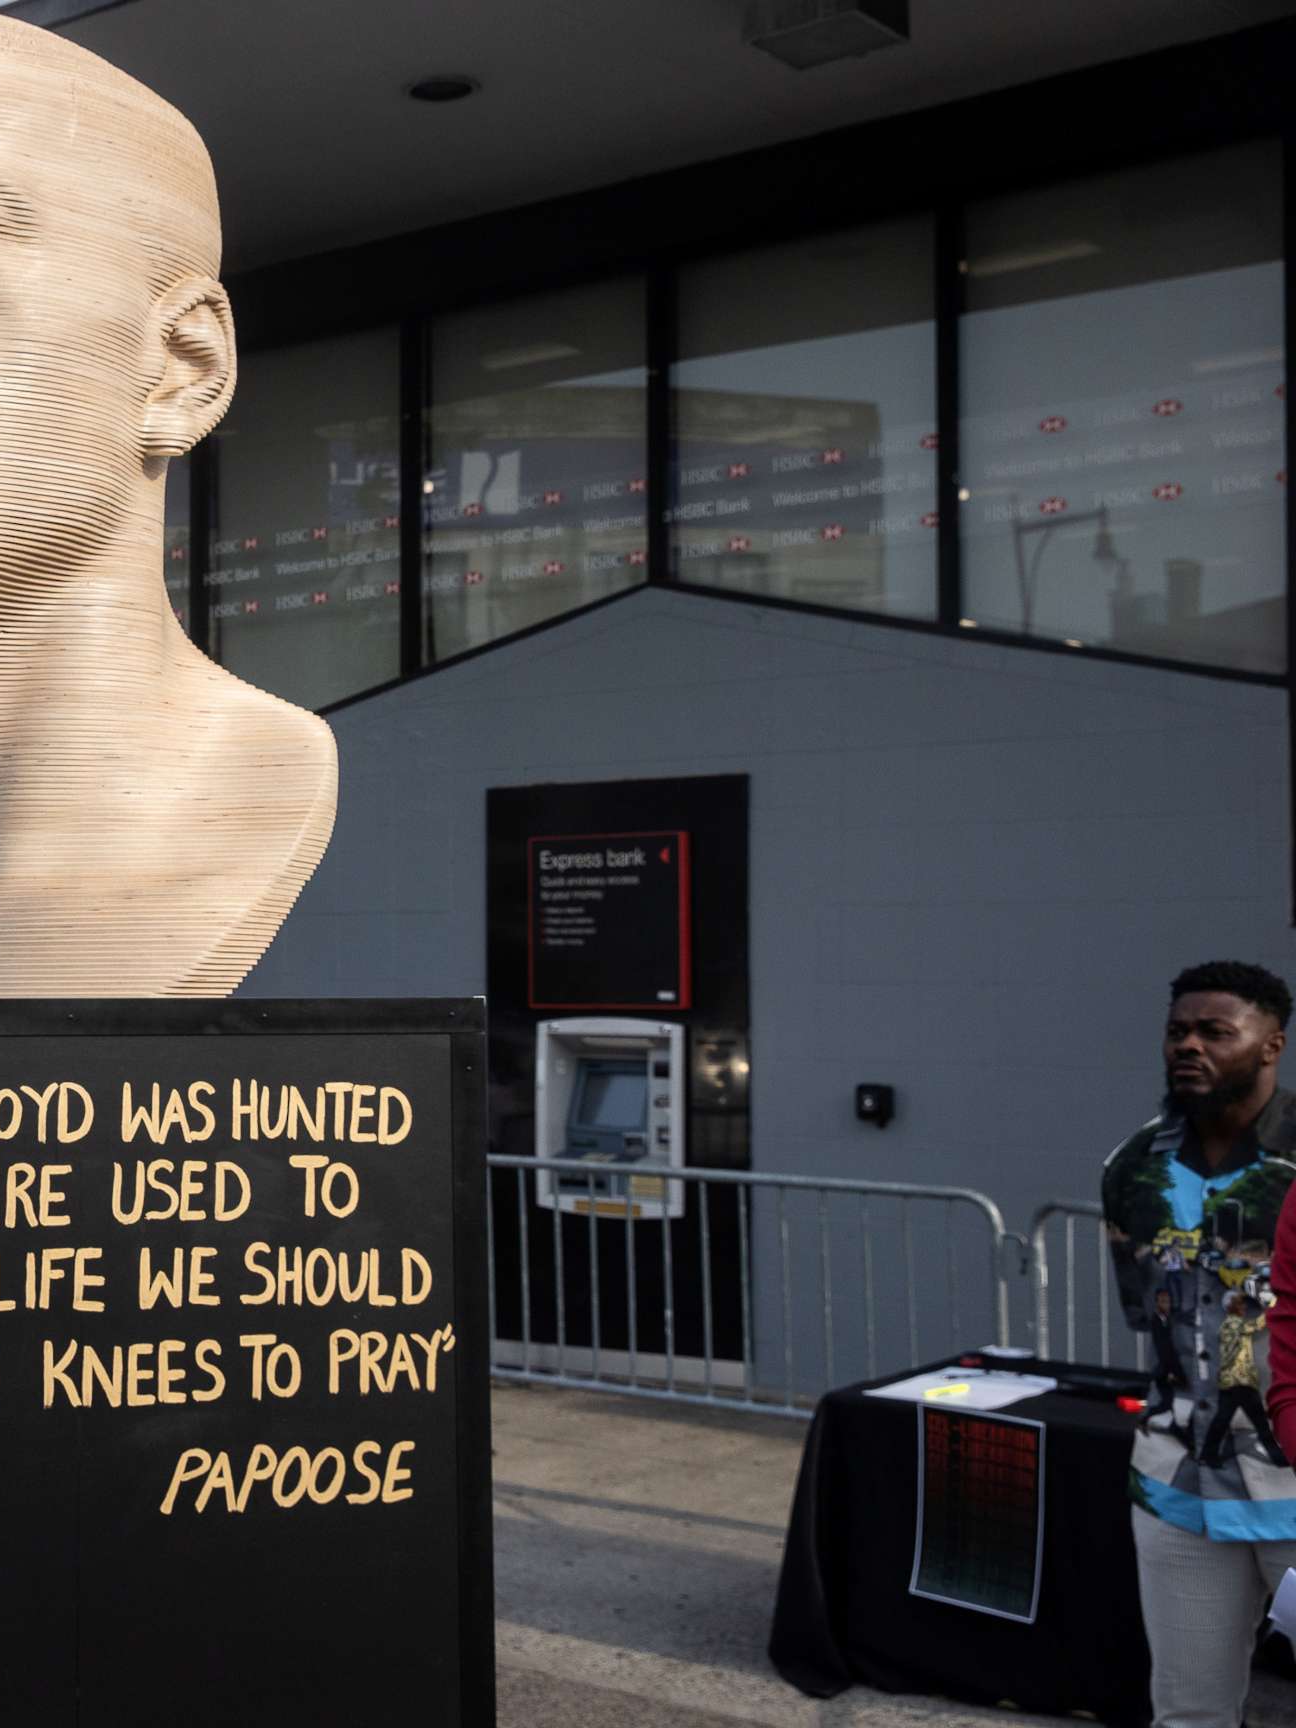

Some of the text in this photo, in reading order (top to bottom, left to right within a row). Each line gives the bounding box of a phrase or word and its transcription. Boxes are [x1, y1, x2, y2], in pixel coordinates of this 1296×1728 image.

[539, 848, 646, 872] Express bank
[121, 1081, 216, 1145] WAS
[231, 1078, 413, 1145] HUNTED
[111, 1158, 252, 1226] USED
[288, 1154, 360, 1218] TO
[138, 1246, 221, 1310] WE
[239, 1241, 433, 1307] SHOULD
[43, 1338, 225, 1408] KNEES
[239, 1333, 302, 1401] TO
[159, 1440, 415, 1515] PAPOOSE
